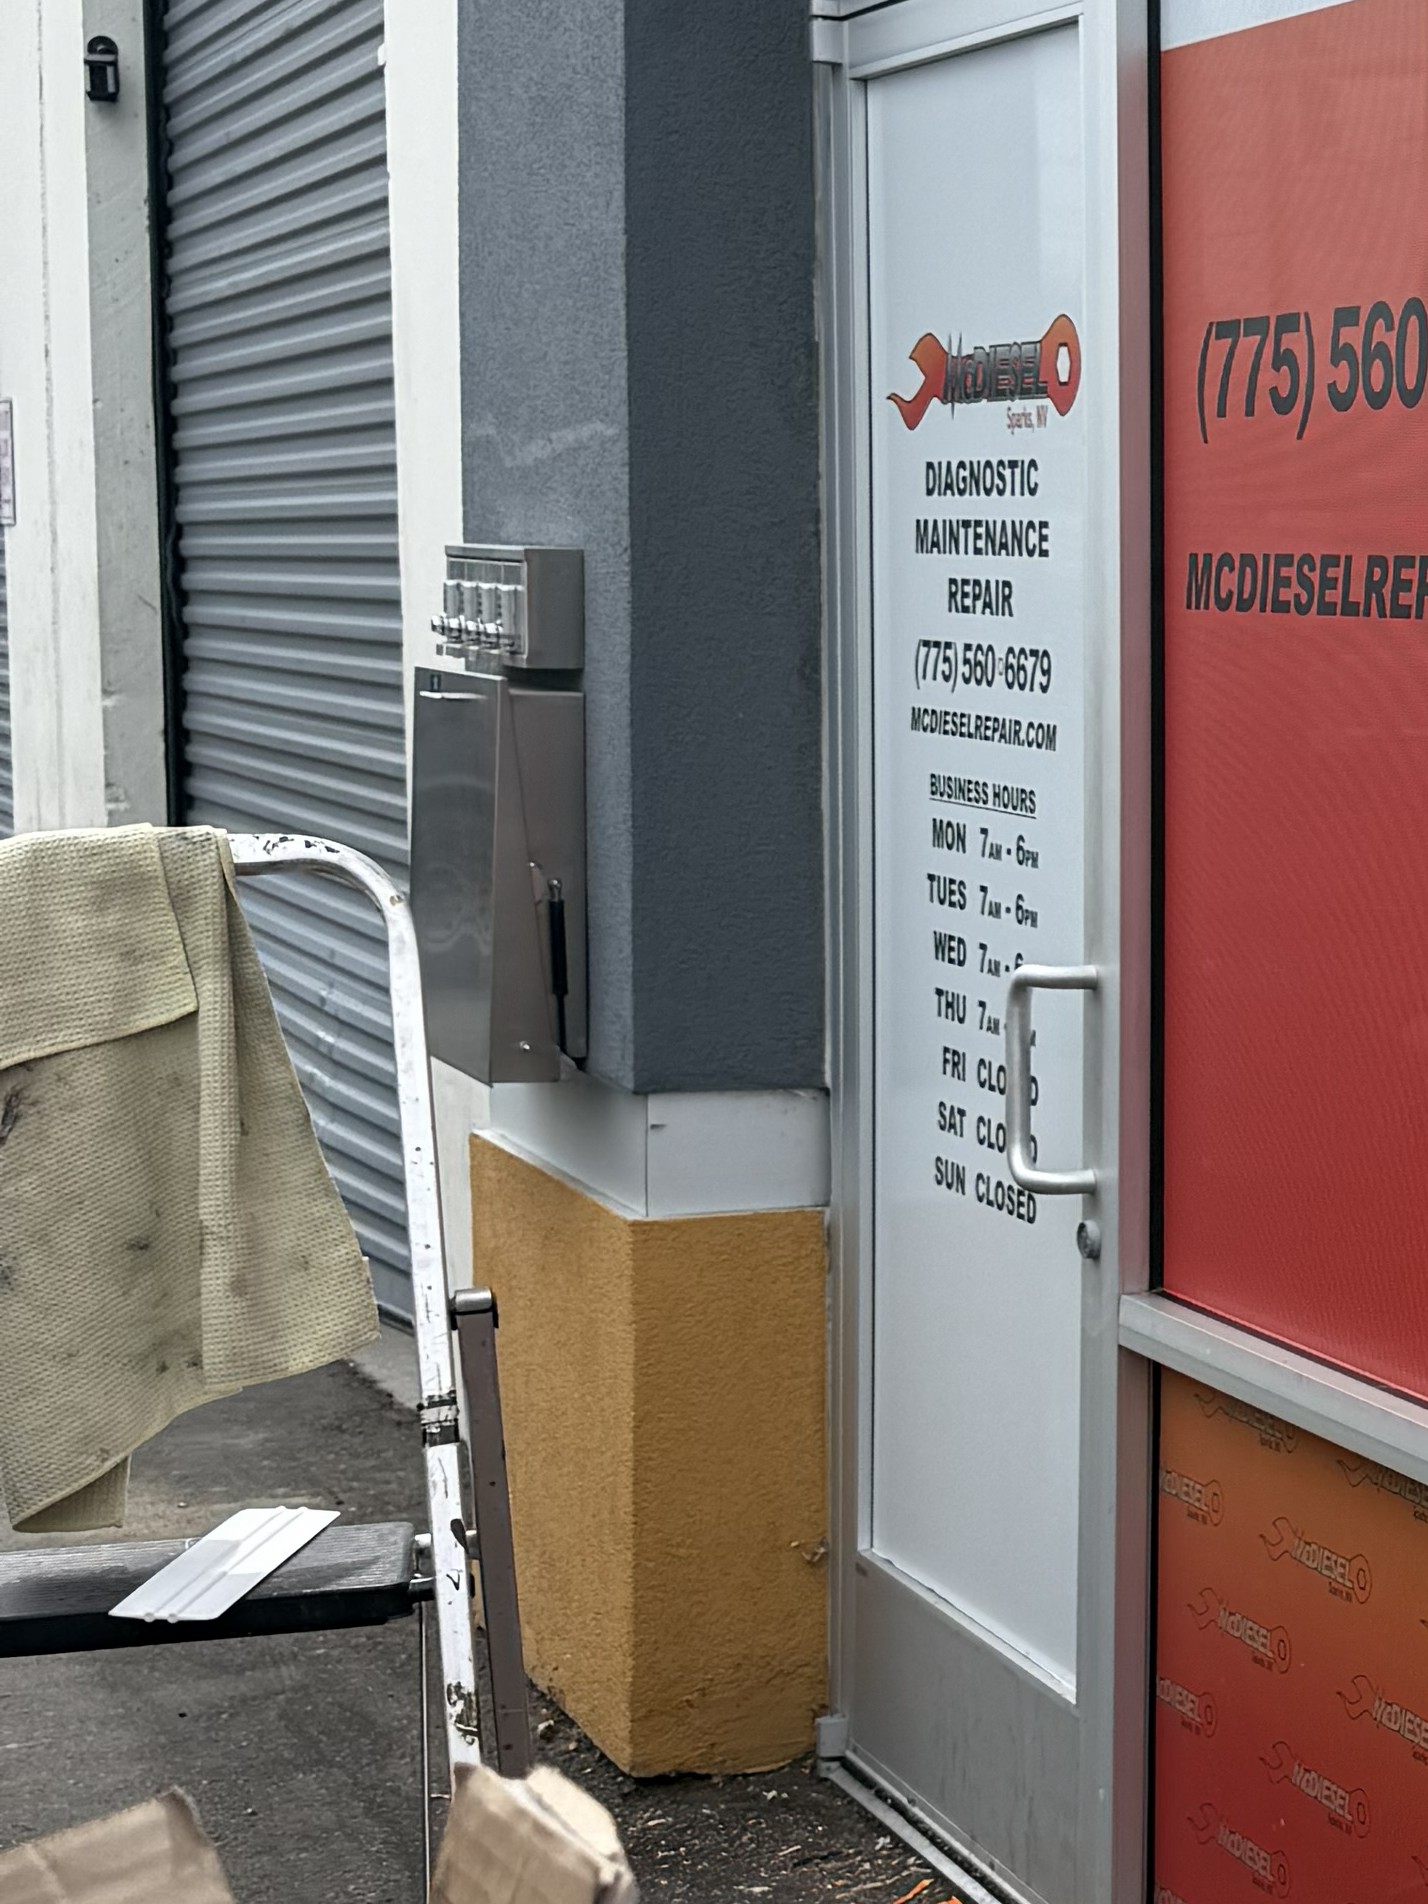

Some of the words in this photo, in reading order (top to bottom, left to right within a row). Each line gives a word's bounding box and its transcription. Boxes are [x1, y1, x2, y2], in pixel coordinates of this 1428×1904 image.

[1197, 312, 1315, 444] (775)
[925, 459, 1039, 497] DIAGNOSTIC
[915, 519, 1050, 557] MAINTENANCE
[948, 578, 1014, 617] REPAIR
[915, 639, 957, 693] (775)
[911, 706, 1057, 751] MCDIESELREPAIR.COM
[930, 773, 989, 805] BUSINESS
[992, 783, 1037, 814] HOURS
[932, 818, 966, 854] MON
[927, 873, 967, 910] TUES
[933, 930, 966, 967] WED
[935, 987, 966, 1024] THU
[942, 1046, 966, 1081] FRI
[977, 1058, 1039, 1106] CLOD
[938, 1100, 966, 1138] SAT
[976, 1115, 1038, 1165] CLOD
[934, 1156, 966, 1196] SUN
[975, 1172, 1037, 1224] CLOSED
